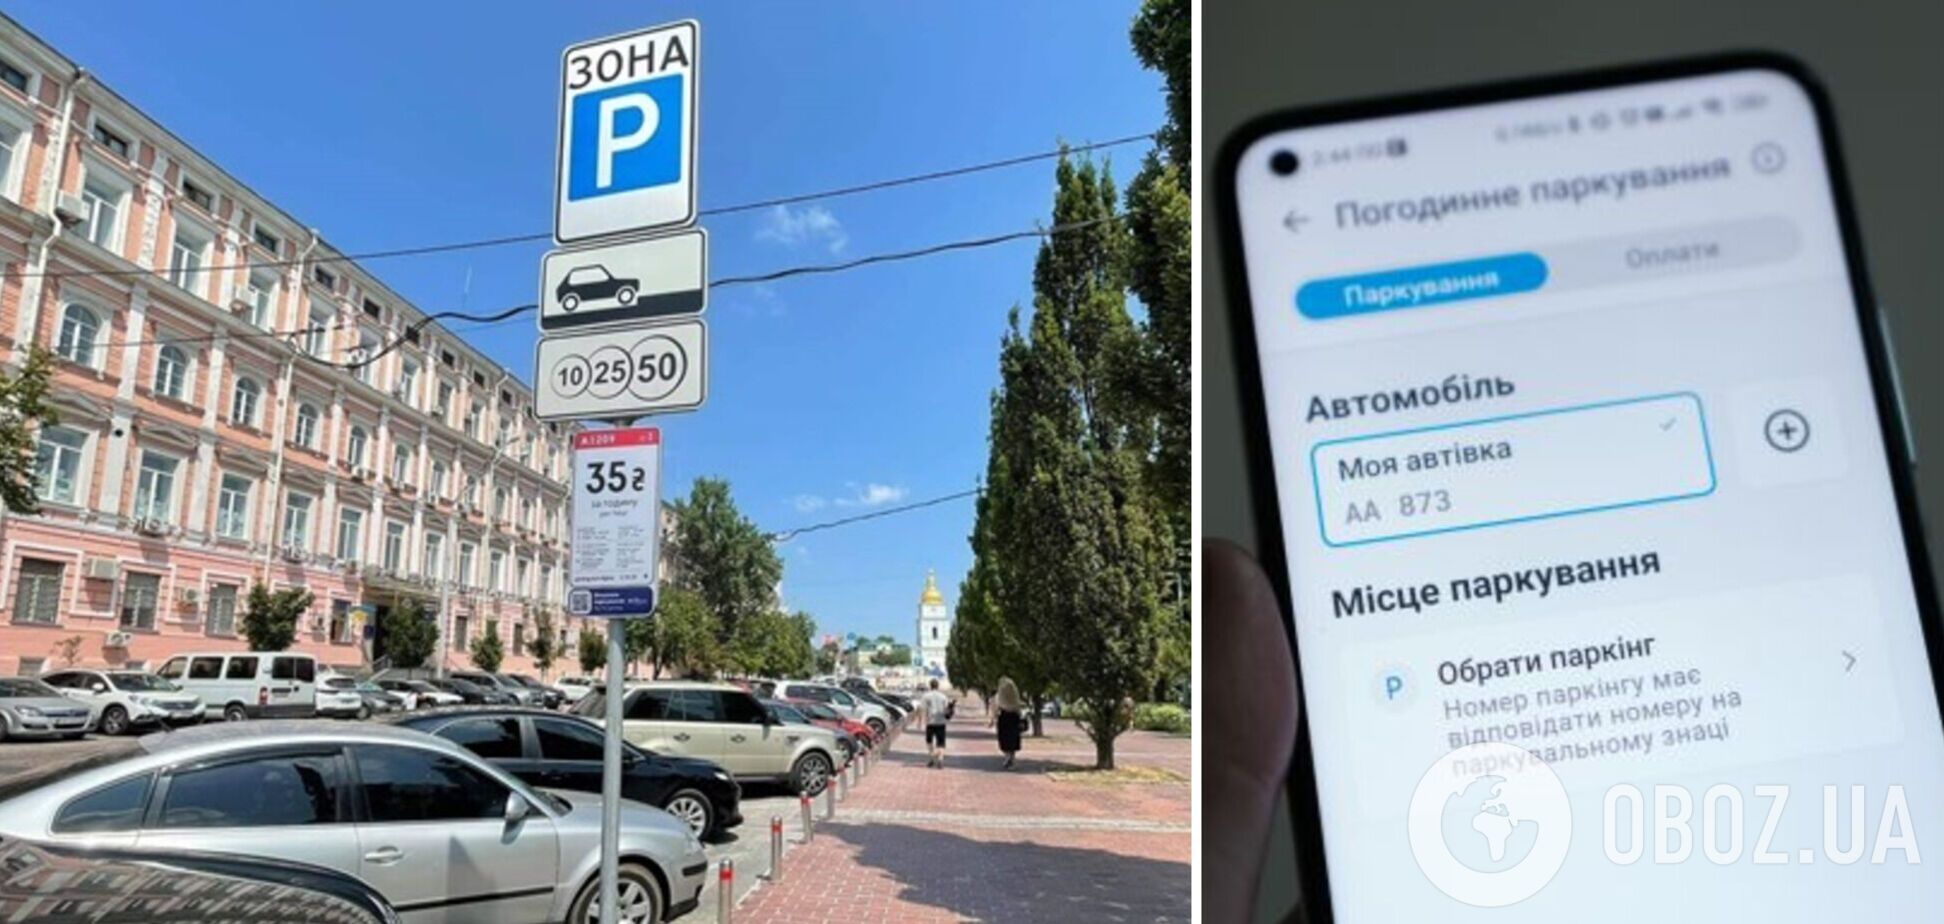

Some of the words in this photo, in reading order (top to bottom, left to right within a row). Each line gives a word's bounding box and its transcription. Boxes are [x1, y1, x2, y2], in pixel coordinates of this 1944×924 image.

[569, 35, 689, 90] ЗОНА
[596, 92, 660, 188] P
[1335, 185, 1520, 229] Погодинне
[1530, 157, 1731, 205] паркування
[1625, 242, 1720, 270] Оплати
[1343, 270, 1499, 309] Паркування
[558, 366, 583, 387] 10
[594, 360, 626, 384] 25
[637, 352, 677, 383] 50
[1306, 374, 1516, 423] Автомобіль
[1338, 454, 1398, 482] Моя
[1407, 439, 1512, 473] автівка
[1398, 489, 1452, 519] 873
[1331, 582, 1441, 619] Місце
[1450, 550, 1661, 605] паркування
[1437, 650, 1543, 686] Обрати
[1550, 634, 1656, 672] паркінг
[1443, 689, 1529, 720] Номер
[1536, 673, 1644, 708] паркінгу
[1653, 666, 1701, 689] має
[1448, 711, 1600, 750] відповідати
[1610, 697, 1704, 727] номеру
[1713, 689, 1742, 711] на
[1453, 732, 1653, 780] паркувальному
[1662, 717, 1731, 748] знаці
